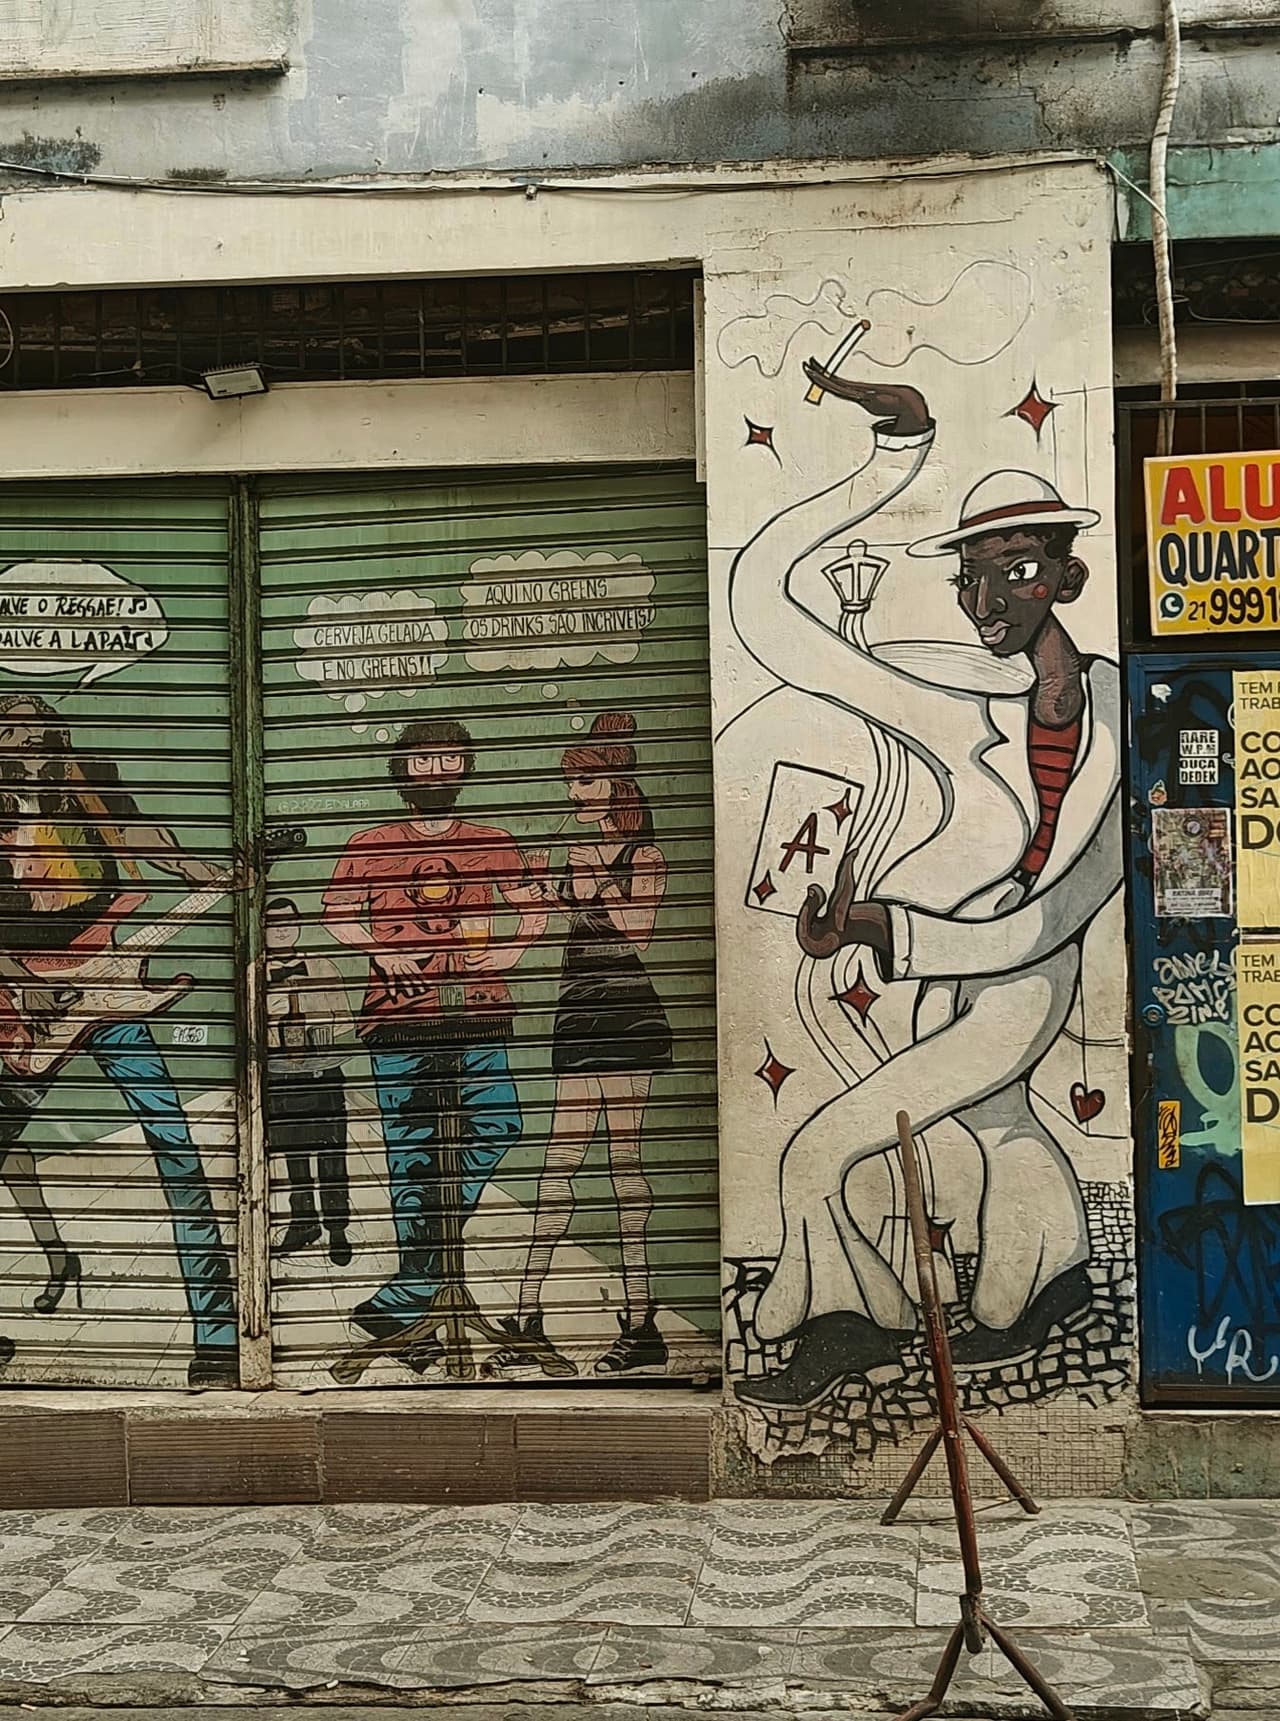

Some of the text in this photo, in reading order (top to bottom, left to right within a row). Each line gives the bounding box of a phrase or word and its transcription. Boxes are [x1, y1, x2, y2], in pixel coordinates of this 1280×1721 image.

[485, 579, 608, 605] AQUI NO GREENS
[38, 598, 48, 613] O
[1188, 601, 1206, 621] 21
[314, 623, 435, 646] CERVEJA GELADA
[470, 619, 488, 638] OS
[491, 616, 544, 638] DRINKS
[49, 630, 62, 648] A
[337, 660, 355, 680] NO
[1240, 682, 1272, 694] TEM
[777, 812, 831, 873] A
[1242, 954, 1275, 967] TEM
